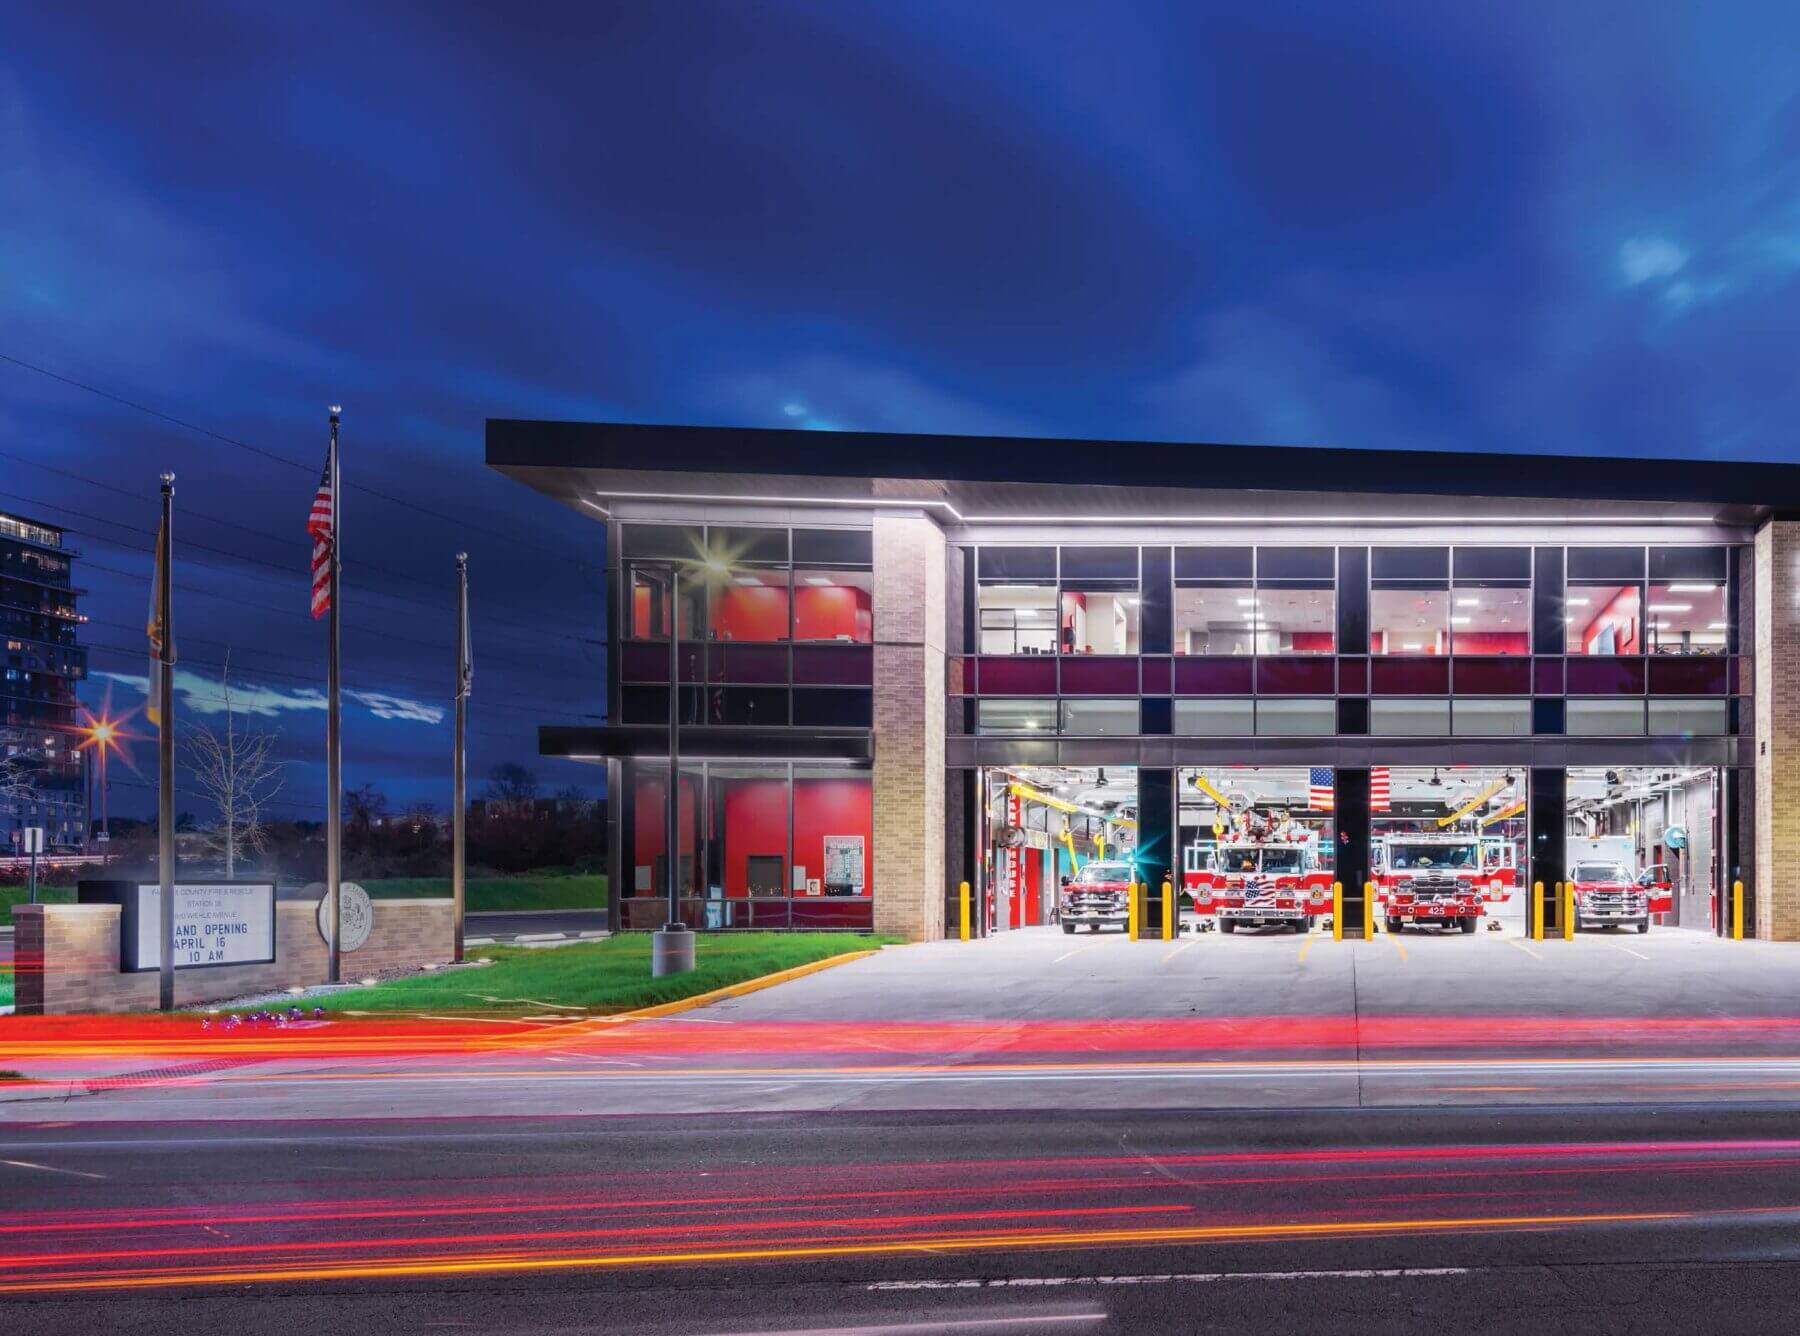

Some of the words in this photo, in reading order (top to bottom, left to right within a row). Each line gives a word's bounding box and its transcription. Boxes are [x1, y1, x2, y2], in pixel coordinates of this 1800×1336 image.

[1428, 907, 1446, 915] 425
[176, 925, 197, 937] AND
[205, 923, 248, 935] OPENING
[174, 938, 205, 949] APRIL
[216, 937, 226, 948] 16
[189, 951, 200, 962] 10
[208, 951, 224, 961] AM
